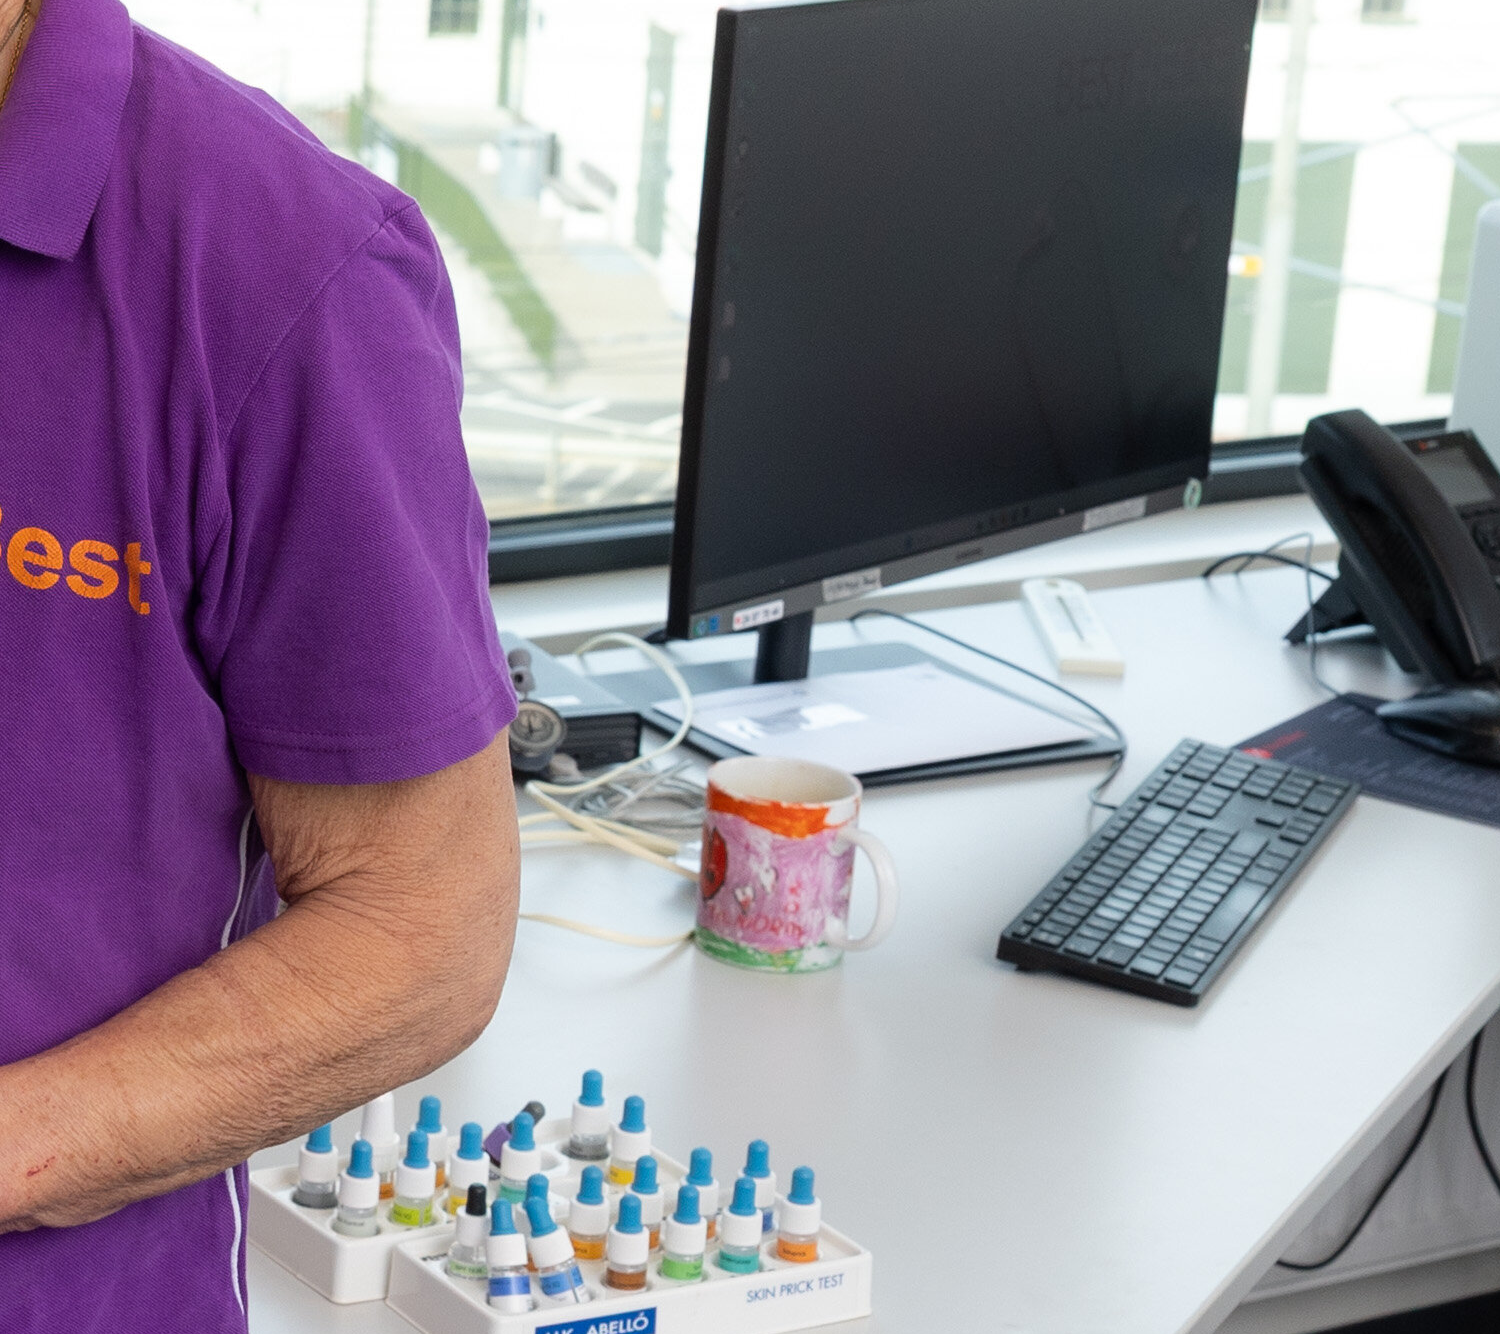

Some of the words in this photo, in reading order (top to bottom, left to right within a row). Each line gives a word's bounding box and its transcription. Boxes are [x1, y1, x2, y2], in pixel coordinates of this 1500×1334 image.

[746, 1286, 776, 1303] SKIN
[780, 1278, 814, 1298] PRICK
[818, 1273, 845, 1288] TEST
